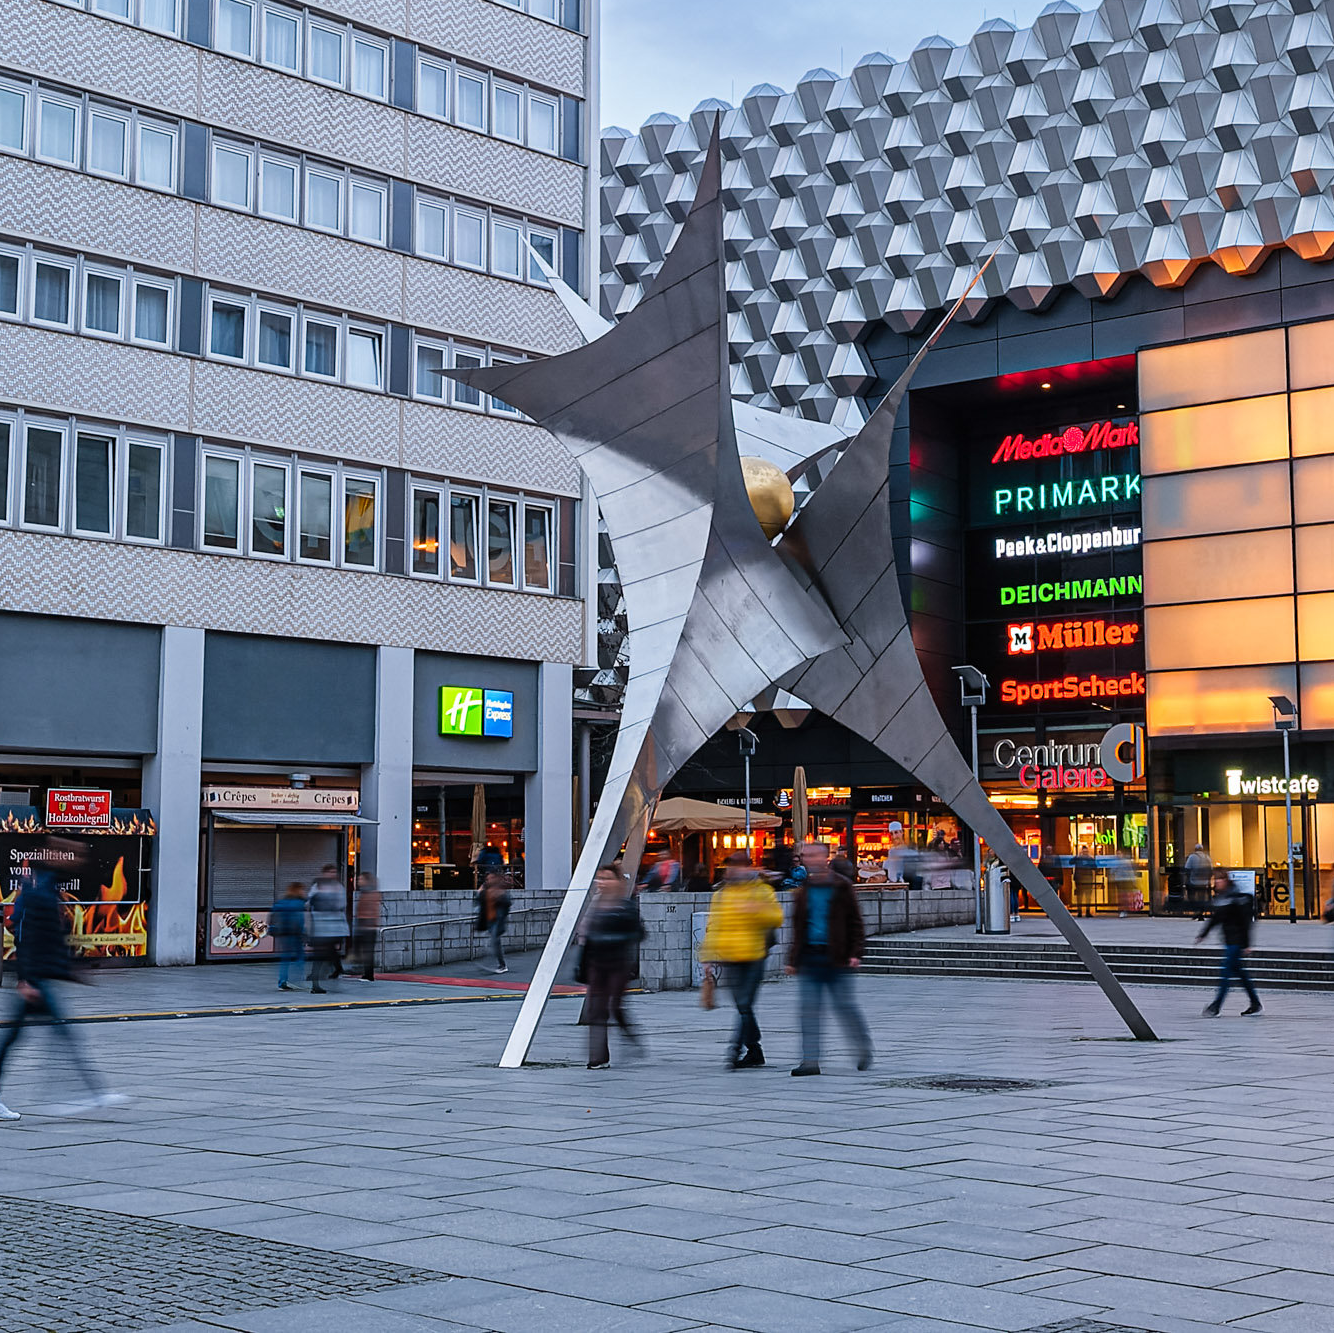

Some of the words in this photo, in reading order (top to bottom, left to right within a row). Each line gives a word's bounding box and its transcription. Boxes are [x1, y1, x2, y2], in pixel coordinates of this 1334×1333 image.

[995, 474, 1140, 515] PRIMARK
[1000, 574, 1143, 606] DEICHMANN
[1036, 620, 1139, 651] Müller
[1001, 672, 1146, 705] SportScheck
[1019, 764, 1107, 789] Galerie
[54, 793, 105, 803] Rostbratwurst
[223, 791, 257, 804] Crêpes
[314, 793, 346, 806] Crêpes
[48, 813, 109, 826] Holzkohlegrill
[9, 866, 32, 876] vom
